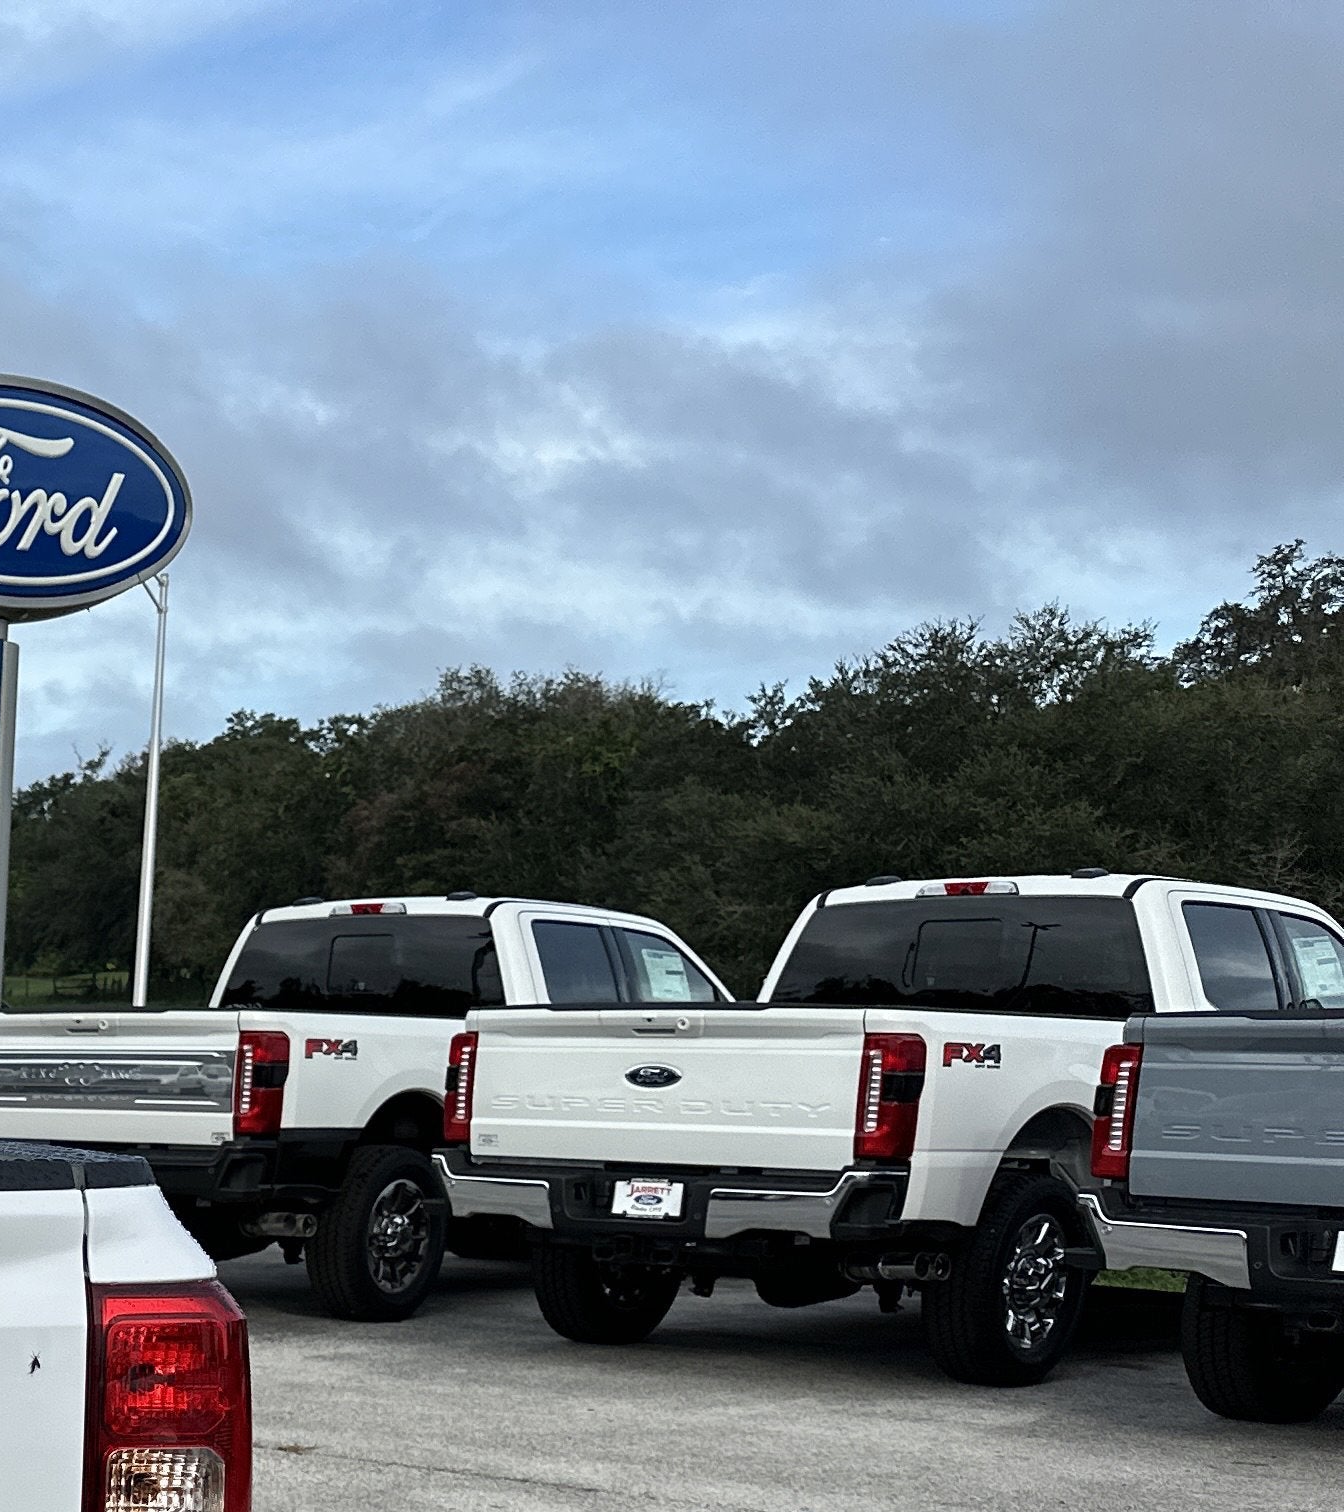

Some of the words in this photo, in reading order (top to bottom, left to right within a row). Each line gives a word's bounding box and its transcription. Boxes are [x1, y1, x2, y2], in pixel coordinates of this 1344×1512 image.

[305, 1039, 358, 1059] FX4
[943, 1042, 1001, 1067] FX4
[491, 1094, 663, 1114] SUPER
[680, 1100, 832, 1118] DUTY
[626, 1184, 673, 1198] JARRETT
